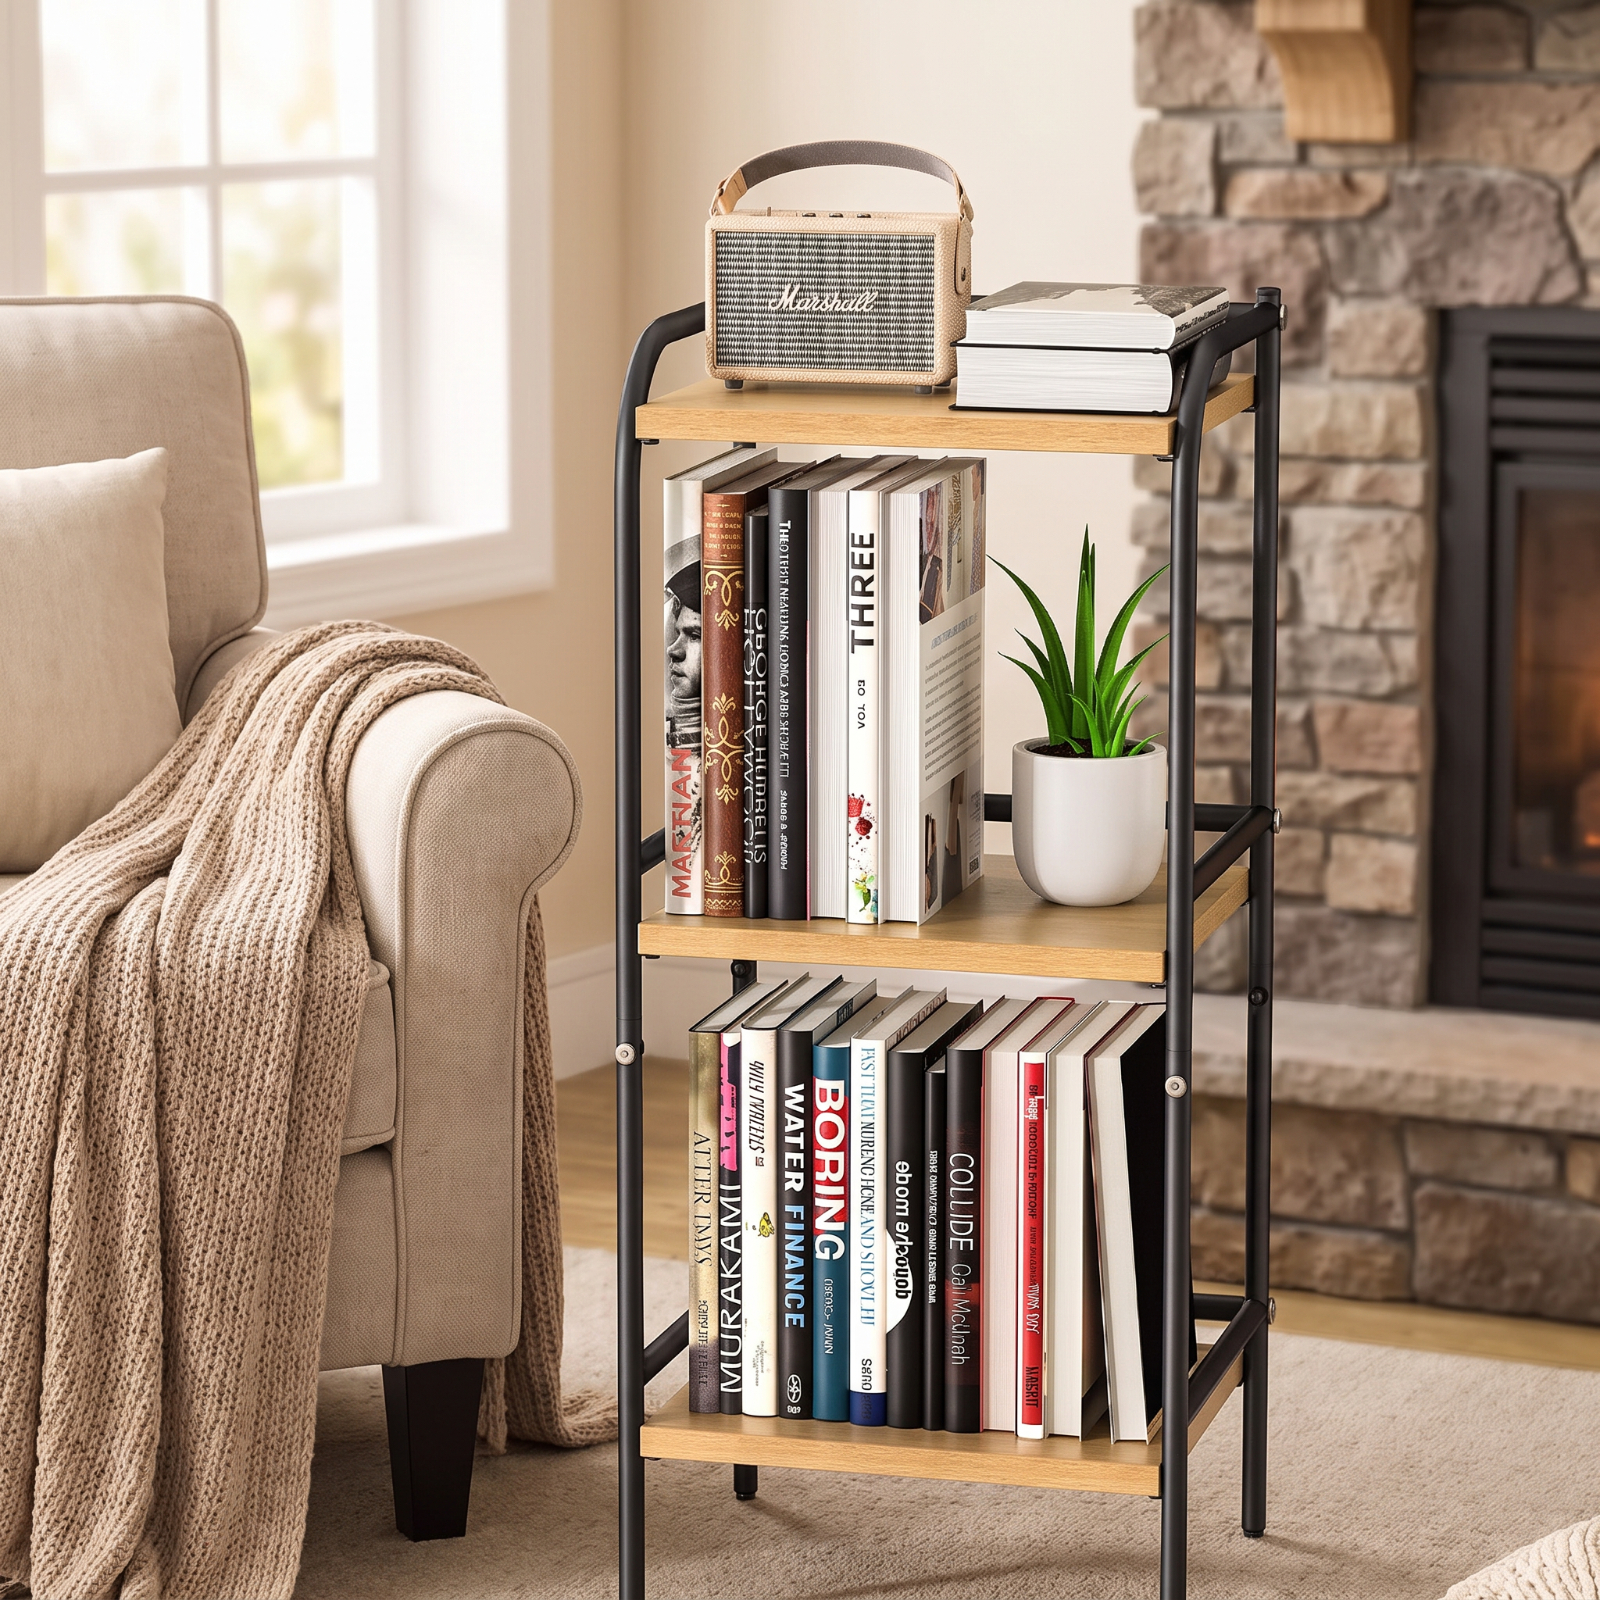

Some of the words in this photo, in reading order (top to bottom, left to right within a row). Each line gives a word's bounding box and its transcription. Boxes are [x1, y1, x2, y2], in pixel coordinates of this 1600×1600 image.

[768, 283, 879, 312] Marshall
[850, 532, 875, 655] THREE
[784, 1083, 806, 1193] WATER
[814, 1079, 846, 1261] BORING
[949, 1152, 975, 1251] COLLIDE
[719, 1183, 742, 1393] MURAKAMI
[784, 1204, 806, 1328] FINANCE
